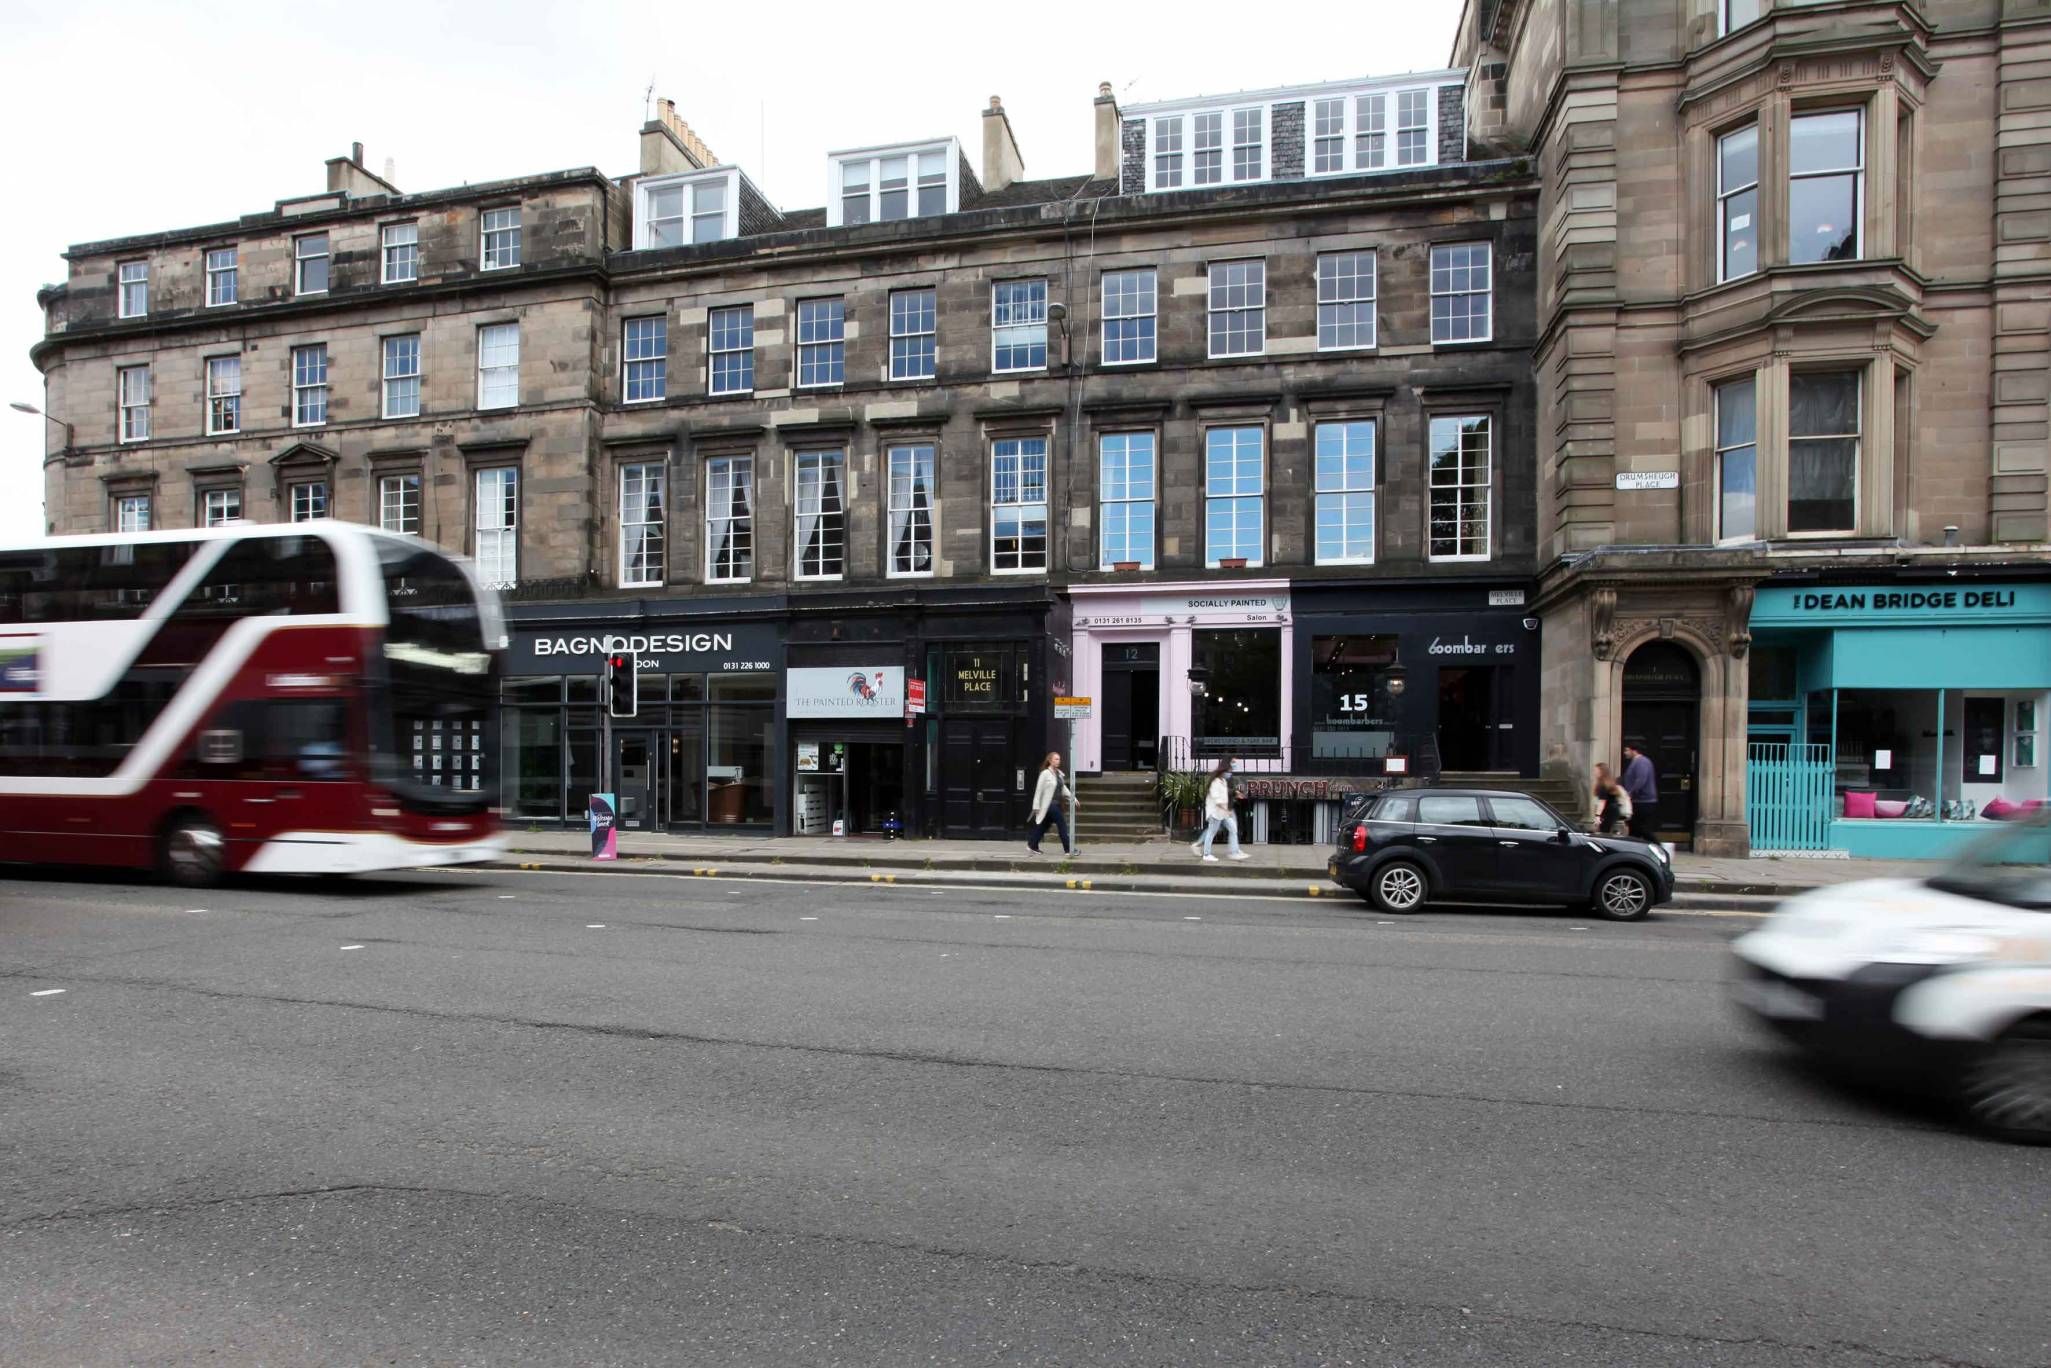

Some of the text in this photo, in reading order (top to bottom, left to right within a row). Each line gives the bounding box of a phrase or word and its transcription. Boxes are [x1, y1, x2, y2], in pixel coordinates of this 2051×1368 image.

[1187, 599, 1267, 608] SOCIALLY PAINTED
[1804, 593, 1866, 610] DEAN
[1872, 592, 1957, 609] BRIDGE
[1964, 591, 2015, 608] DELI
[1125, 649, 1138, 660] 12
[723, 661, 771, 670] 0131 226 1000
[958, 670, 996, 679] MELVILLE
[964, 682, 992, 691] PLACE
[796, 697, 810, 706] THE
[813, 697, 854, 706] PAINTED
[1340, 694, 1368, 711] 15
[1247, 780, 1329, 797] BRUNCH
